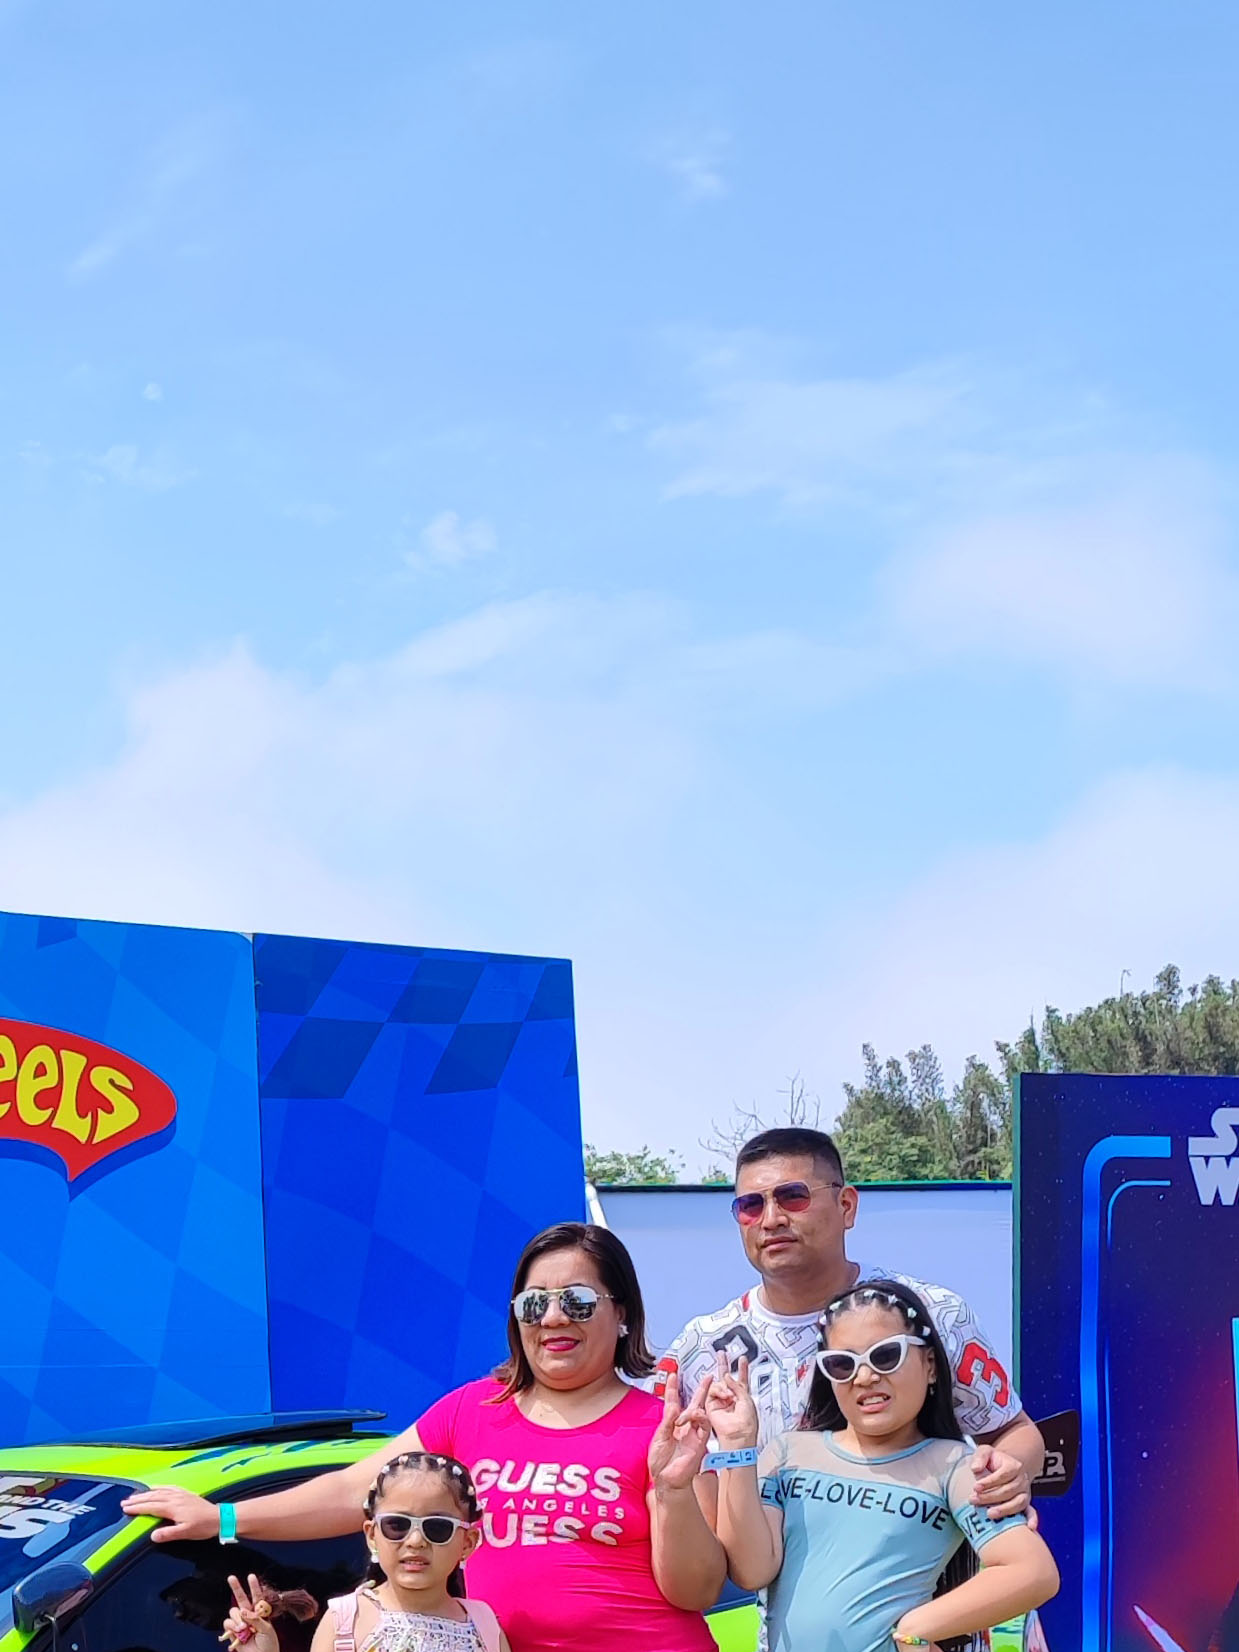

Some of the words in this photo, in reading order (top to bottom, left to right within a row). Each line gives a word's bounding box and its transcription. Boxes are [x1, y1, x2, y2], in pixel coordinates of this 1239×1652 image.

[471, 1458, 622, 1502] GUESS
[40, 1497, 97, 1517] THE
[502, 1498, 625, 1519] ANGELES
[474, 1512, 624, 1549] UESS
